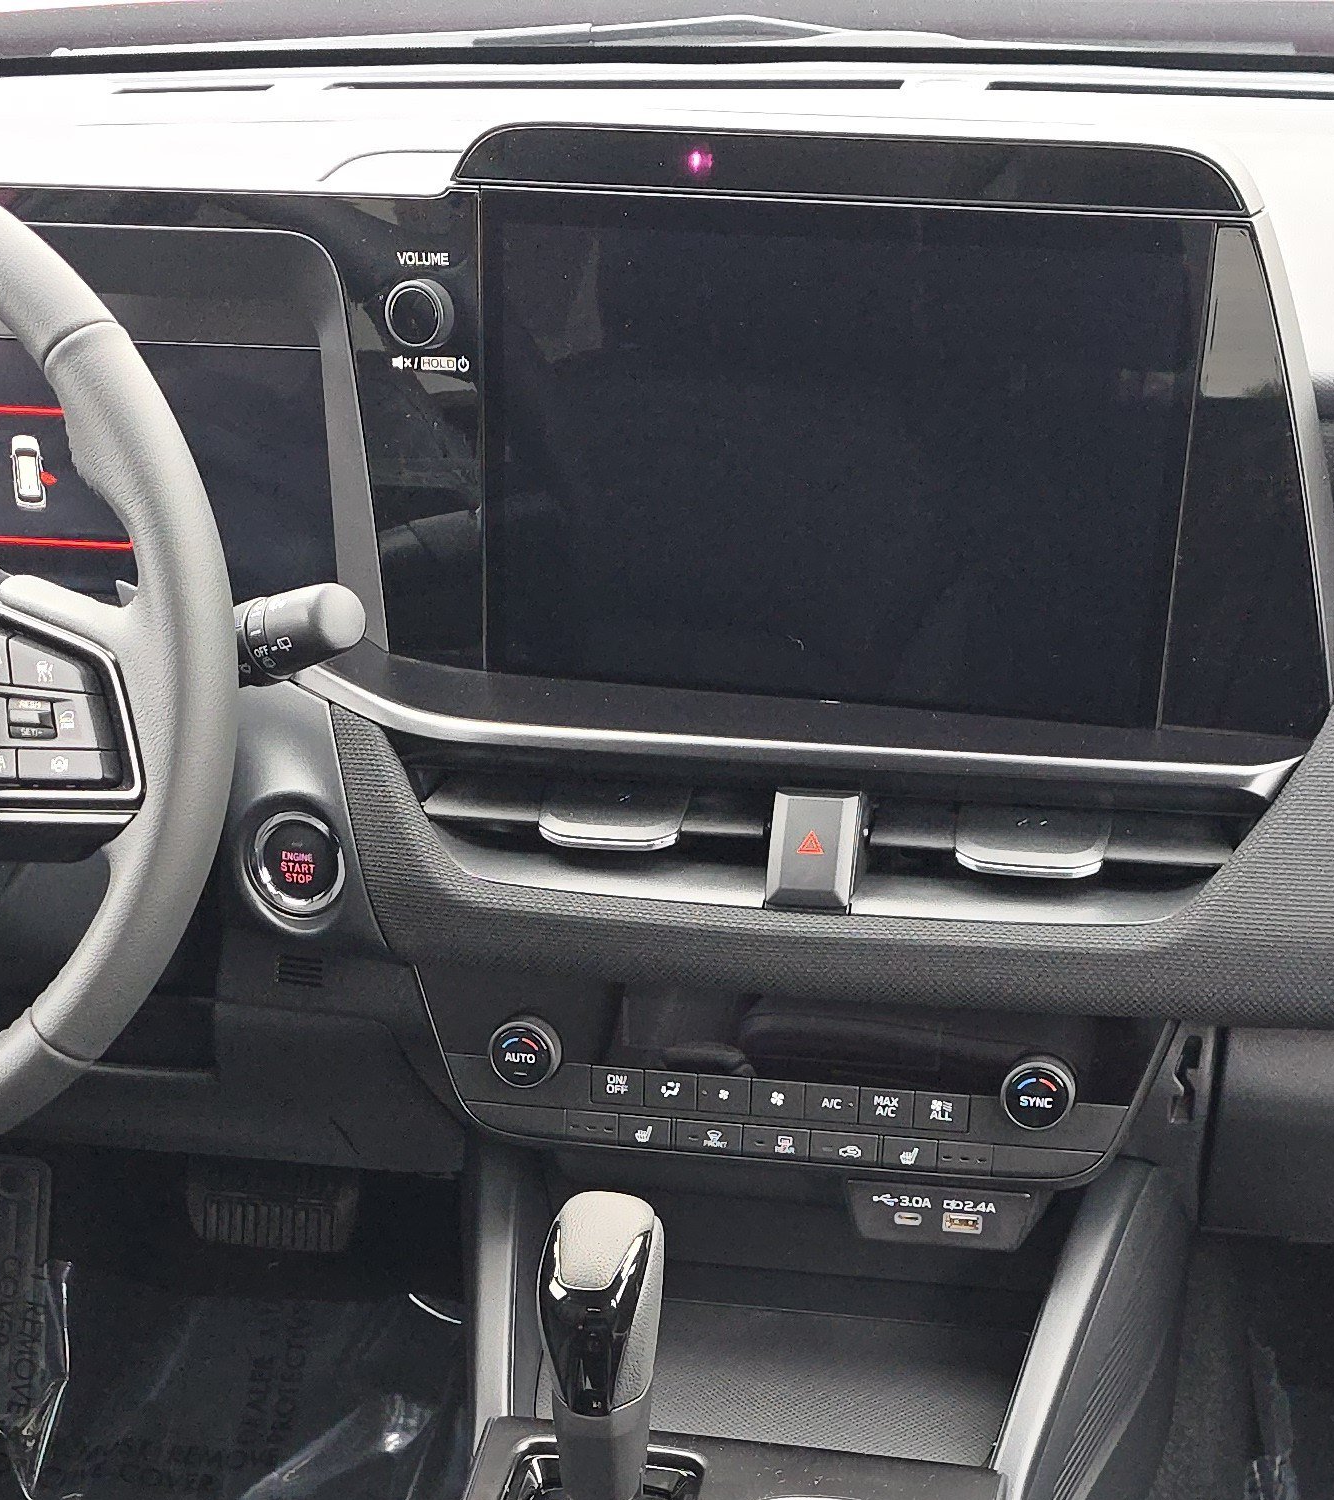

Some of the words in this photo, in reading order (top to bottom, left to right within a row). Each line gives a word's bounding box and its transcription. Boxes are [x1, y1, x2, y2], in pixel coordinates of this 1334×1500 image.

[396, 252, 450, 266] VOLUME
[421, 358, 456, 370] HOLD
[253, 644, 269, 658] OFF
[281, 850, 314, 862] ENGINE
[280, 861, 316, 874] START
[284, 872, 313, 885] STOP
[504, 1051, 536, 1064] AUTO
[606, 1073, 628, 1085] ON/
[606, 1083, 629, 1095] OFF
[821, 1097, 843, 1111] A/C
[873, 1094, 899, 1108] MAX
[1019, 1095, 1054, 1110] SYNC
[875, 1105, 897, 1118] A/C
[929, 1111, 953, 1122] ALL
[899, 1195, 932, 1209] 3.0A
[963, 1200, 997, 1214] 2.4A
[6, 1300, 46, 1416] REMOVE
